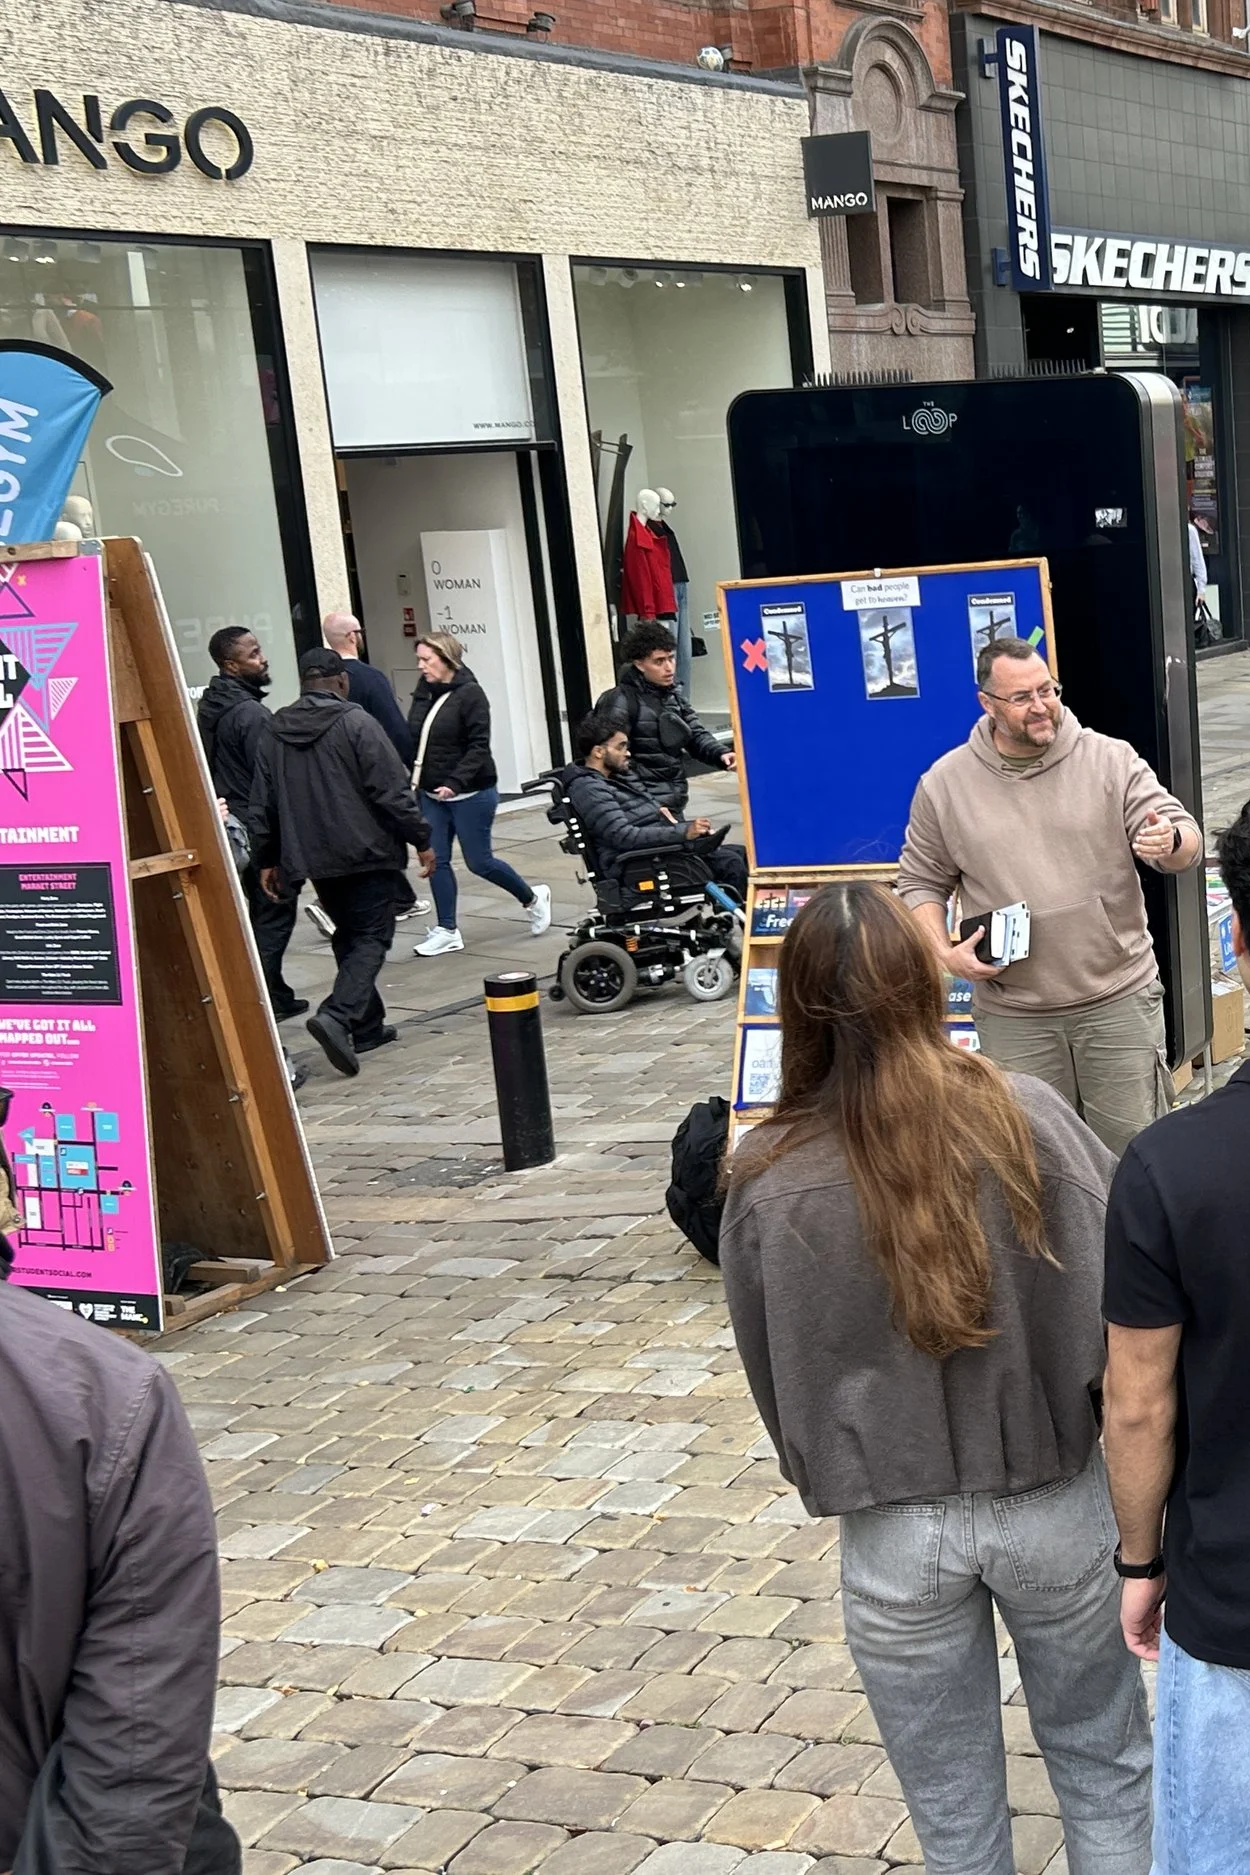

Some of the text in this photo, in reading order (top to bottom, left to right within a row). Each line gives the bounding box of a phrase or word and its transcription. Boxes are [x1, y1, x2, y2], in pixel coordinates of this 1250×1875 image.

[1005, 38, 1041, 281] SKECHERS
[811, 192, 868, 210] MANGO
[902, 408, 958, 435] LOOP
[434, 578, 481, 590] WOMAN
[851, 582, 910, 593] Can bad people
[855, 597, 867, 606] get
[439, 623, 487, 635] WOMAN
[18, 873, 77, 882] ENTERTAINMENT
[21, 882, 77, 890] MARKET STREET
[32, 1018, 55, 1031] GOT
[56, 1018, 71, 1031] IT
[72, 1019, 97, 1032] ALL
[11, 1267, 93, 1279] RSTUDENTSOCIAL.COM
